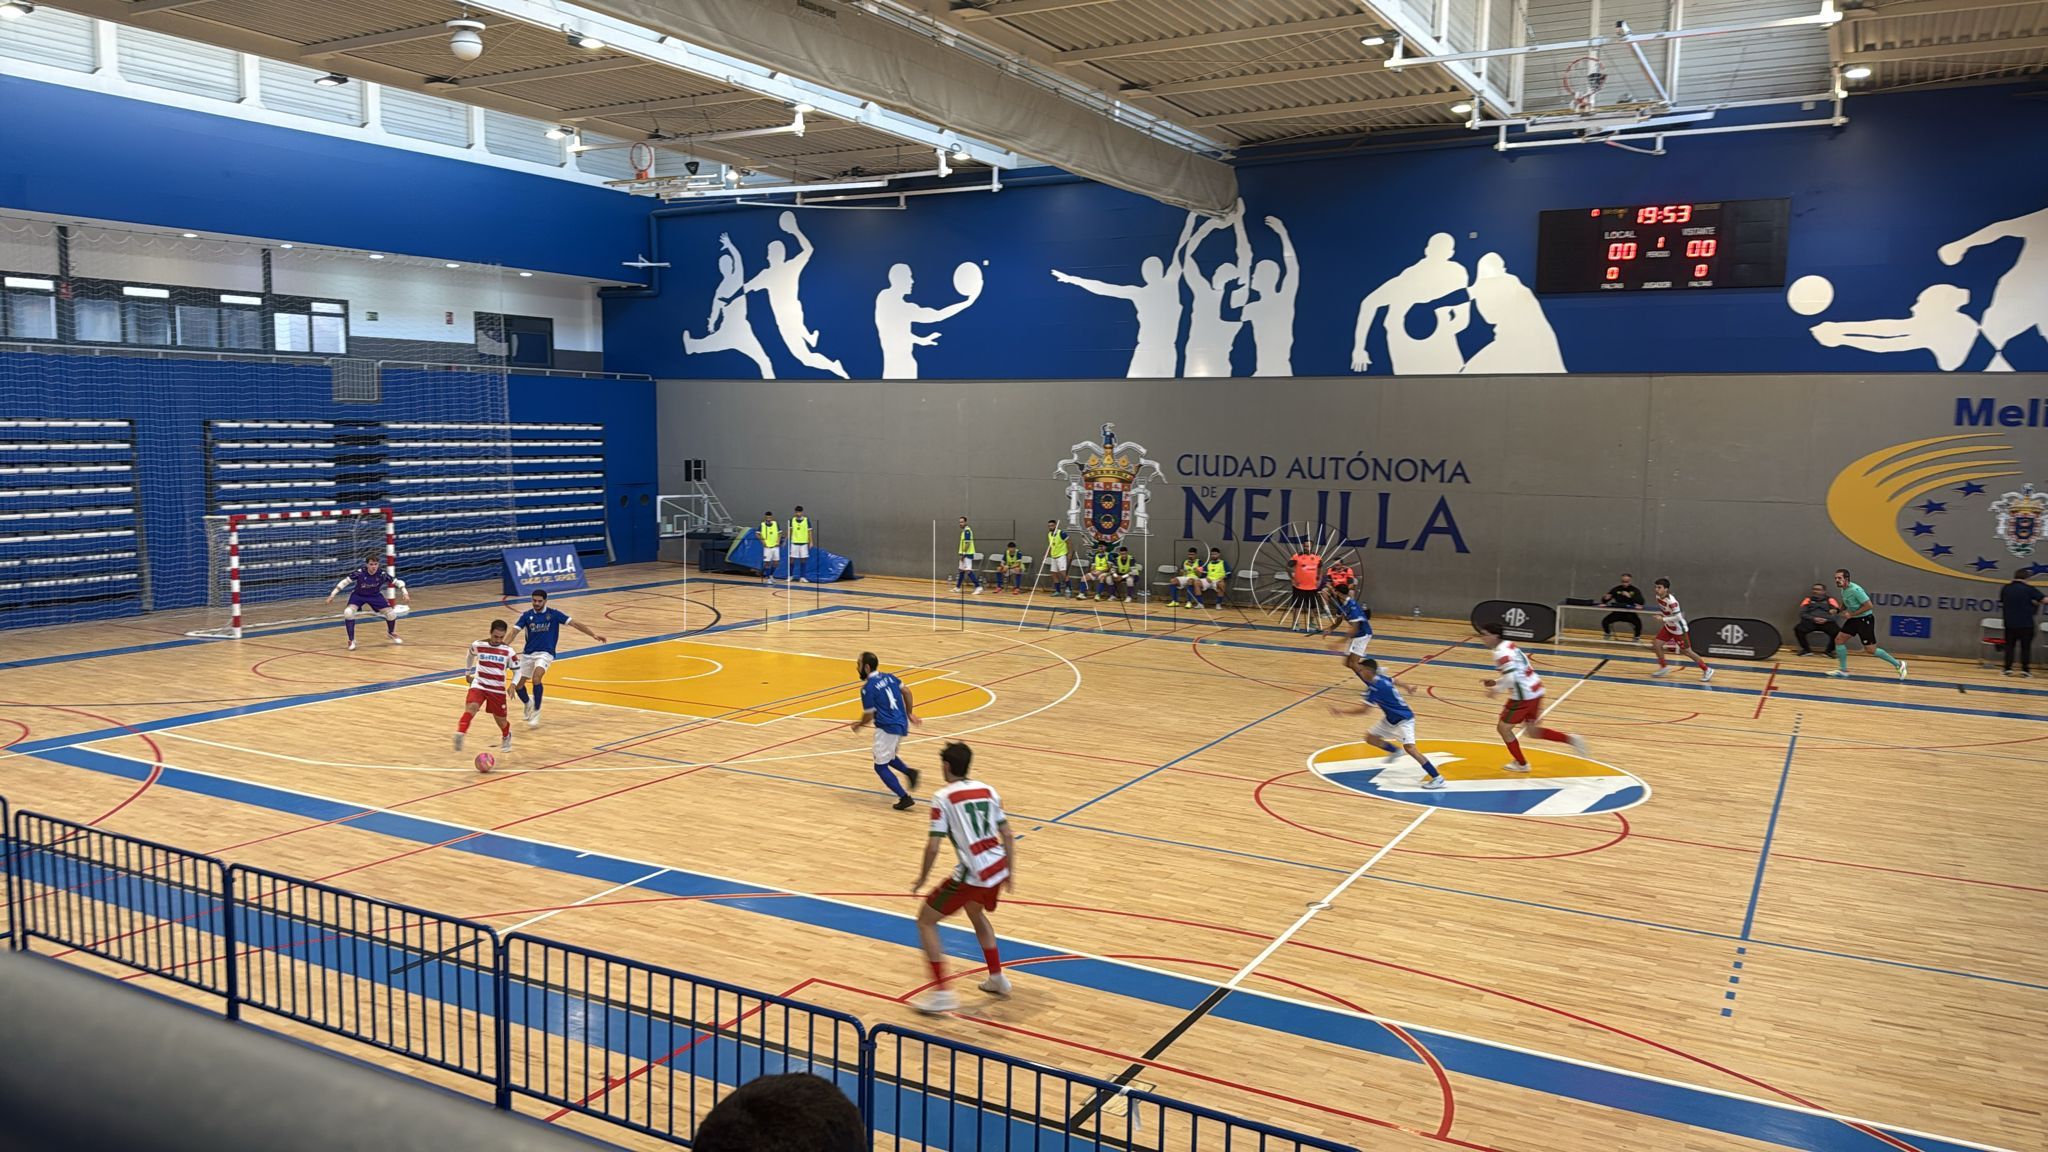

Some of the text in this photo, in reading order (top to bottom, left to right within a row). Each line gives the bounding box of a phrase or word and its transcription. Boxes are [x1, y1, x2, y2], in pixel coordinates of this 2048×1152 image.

[1637, 205, 1692, 224] 19:53
[1604, 230, 1637, 240] LOCAL
[1657, 236, 1665, 248] 1
[1608, 242, 1638, 260] 00
[1686, 239, 1717, 257] 00
[1606, 266, 1620, 280] 0
[1694, 263, 1708, 277] 0
[1176, 451, 1471, 484] CIUDAD AUTÓNOMA
[1201, 486, 1217, 498] DE
[1181, 486, 1471, 553] MELILLA
[514, 554, 577, 577] MELILLA
[1871, 592, 2003, 612] IUDAD EUROP
[964, 801, 991, 838] 17
